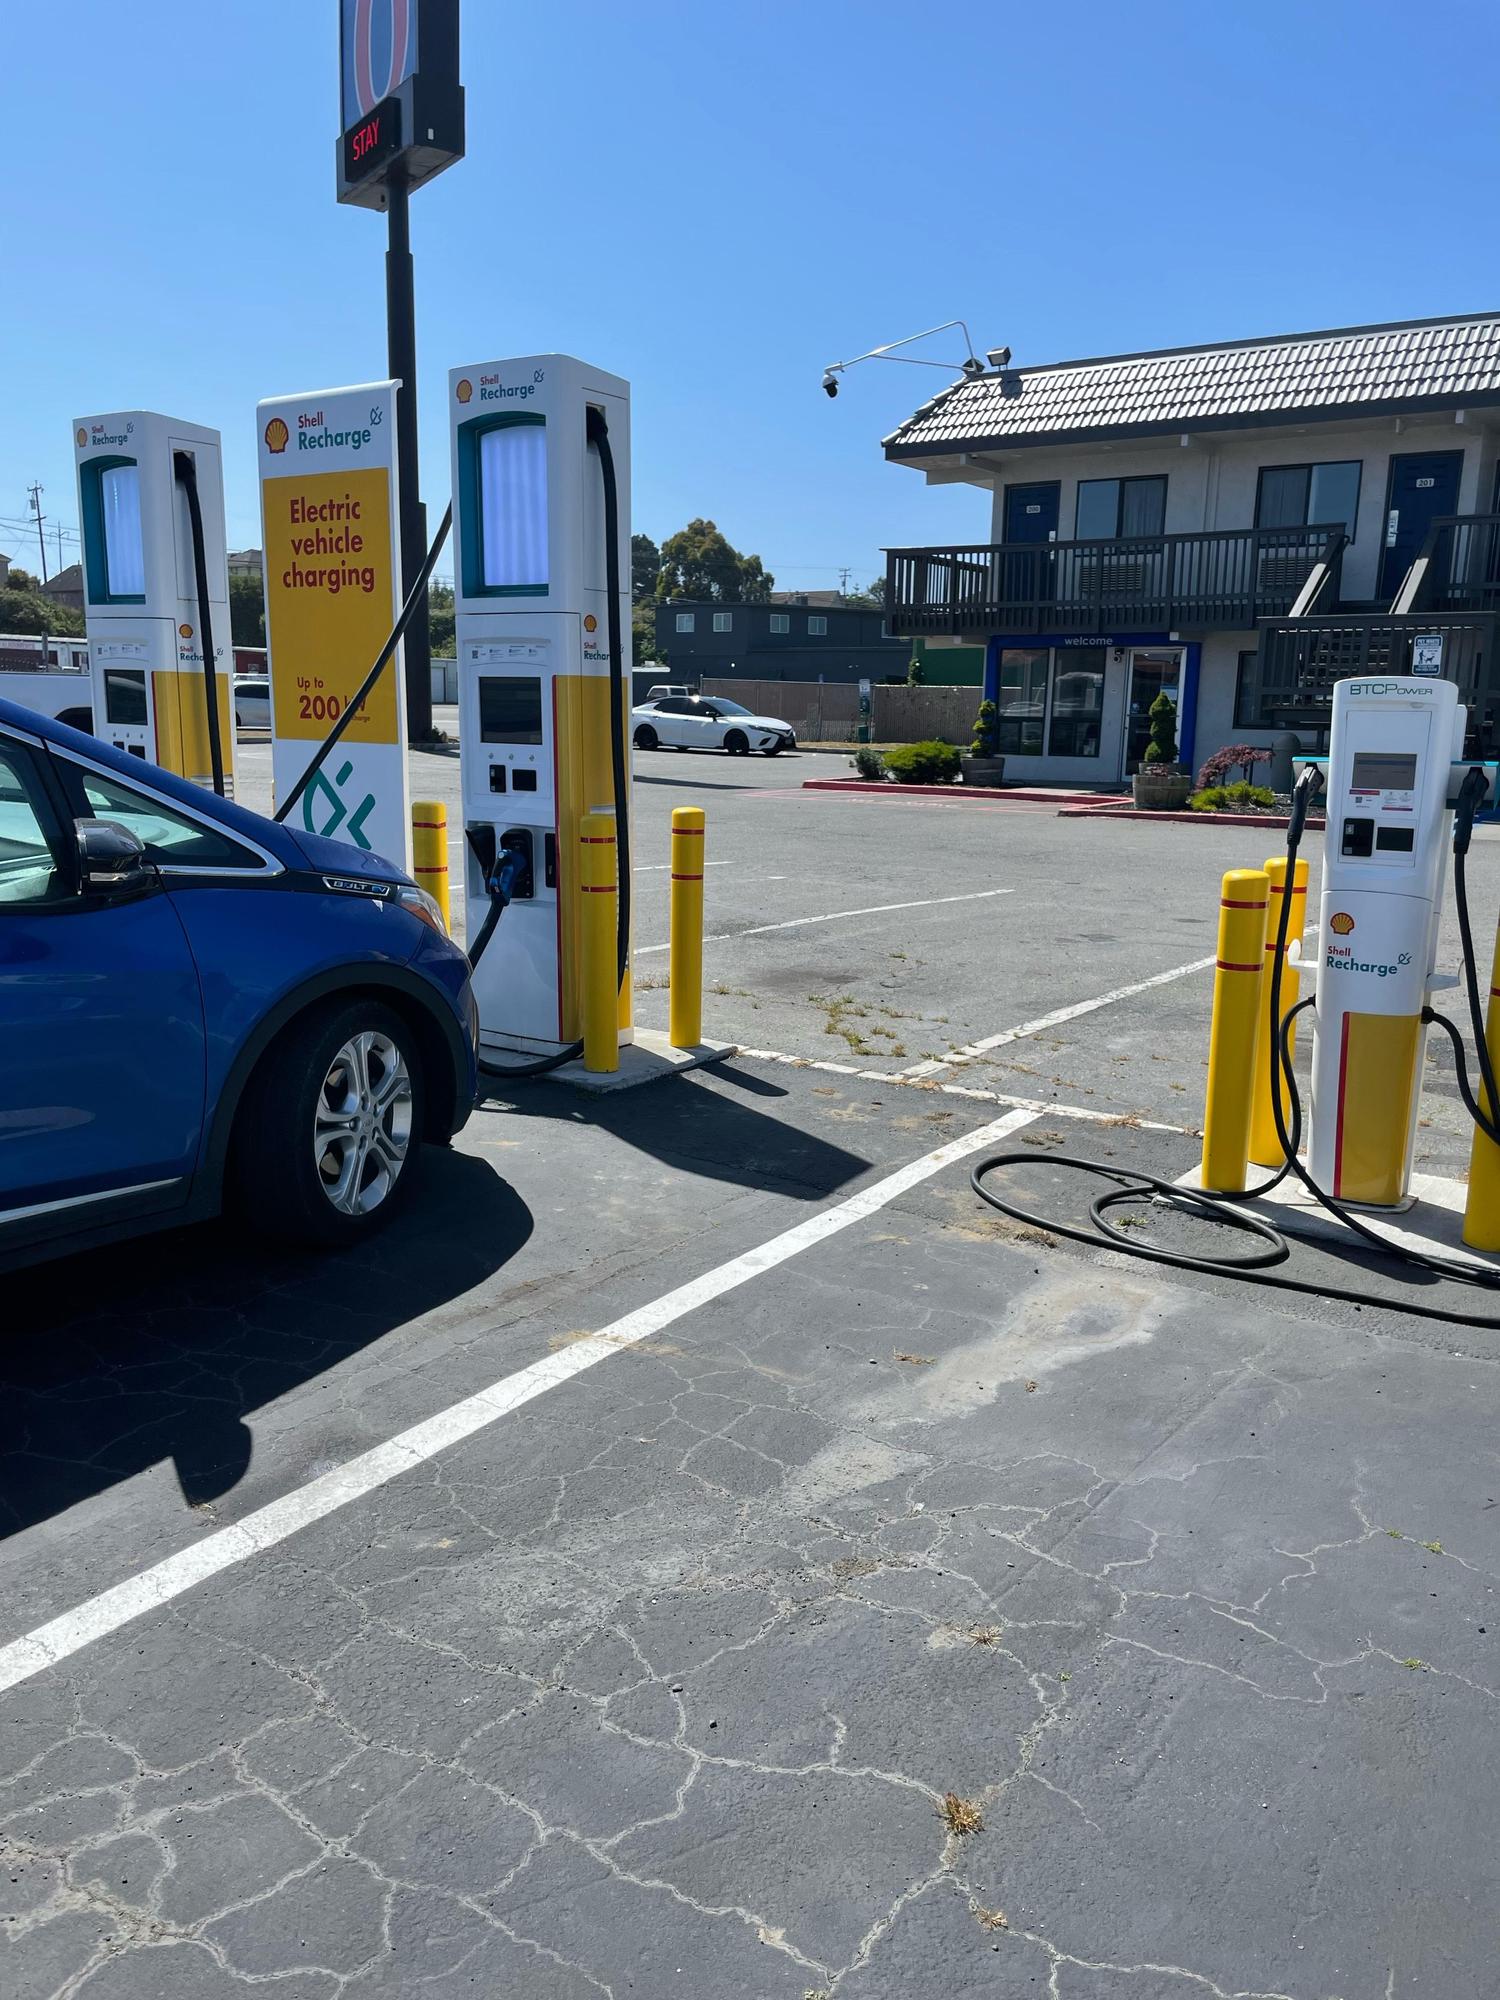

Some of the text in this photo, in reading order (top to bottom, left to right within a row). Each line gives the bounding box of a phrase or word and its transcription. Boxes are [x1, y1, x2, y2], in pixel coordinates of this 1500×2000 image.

[352, 117, 380, 161] STAY
[480, 374, 499, 386] Shell
[480, 384, 535, 400] Recharge
[297, 411, 324, 429] Shell
[92, 433, 128, 446] Recharge
[297, 427, 371, 450] Recharge
[290, 494, 361, 524] Electric
[291, 526, 363, 556] vehicle
[282, 560, 375, 594] charging
[1064, 636, 1113, 646] welcome
[583, 650, 611, 661] Rechar
[297, 677, 324, 691] Up to
[299, 695, 340, 720] 200
[1327, 945, 1351, 957] Shell
[1326, 956, 1398, 978] Recharge
